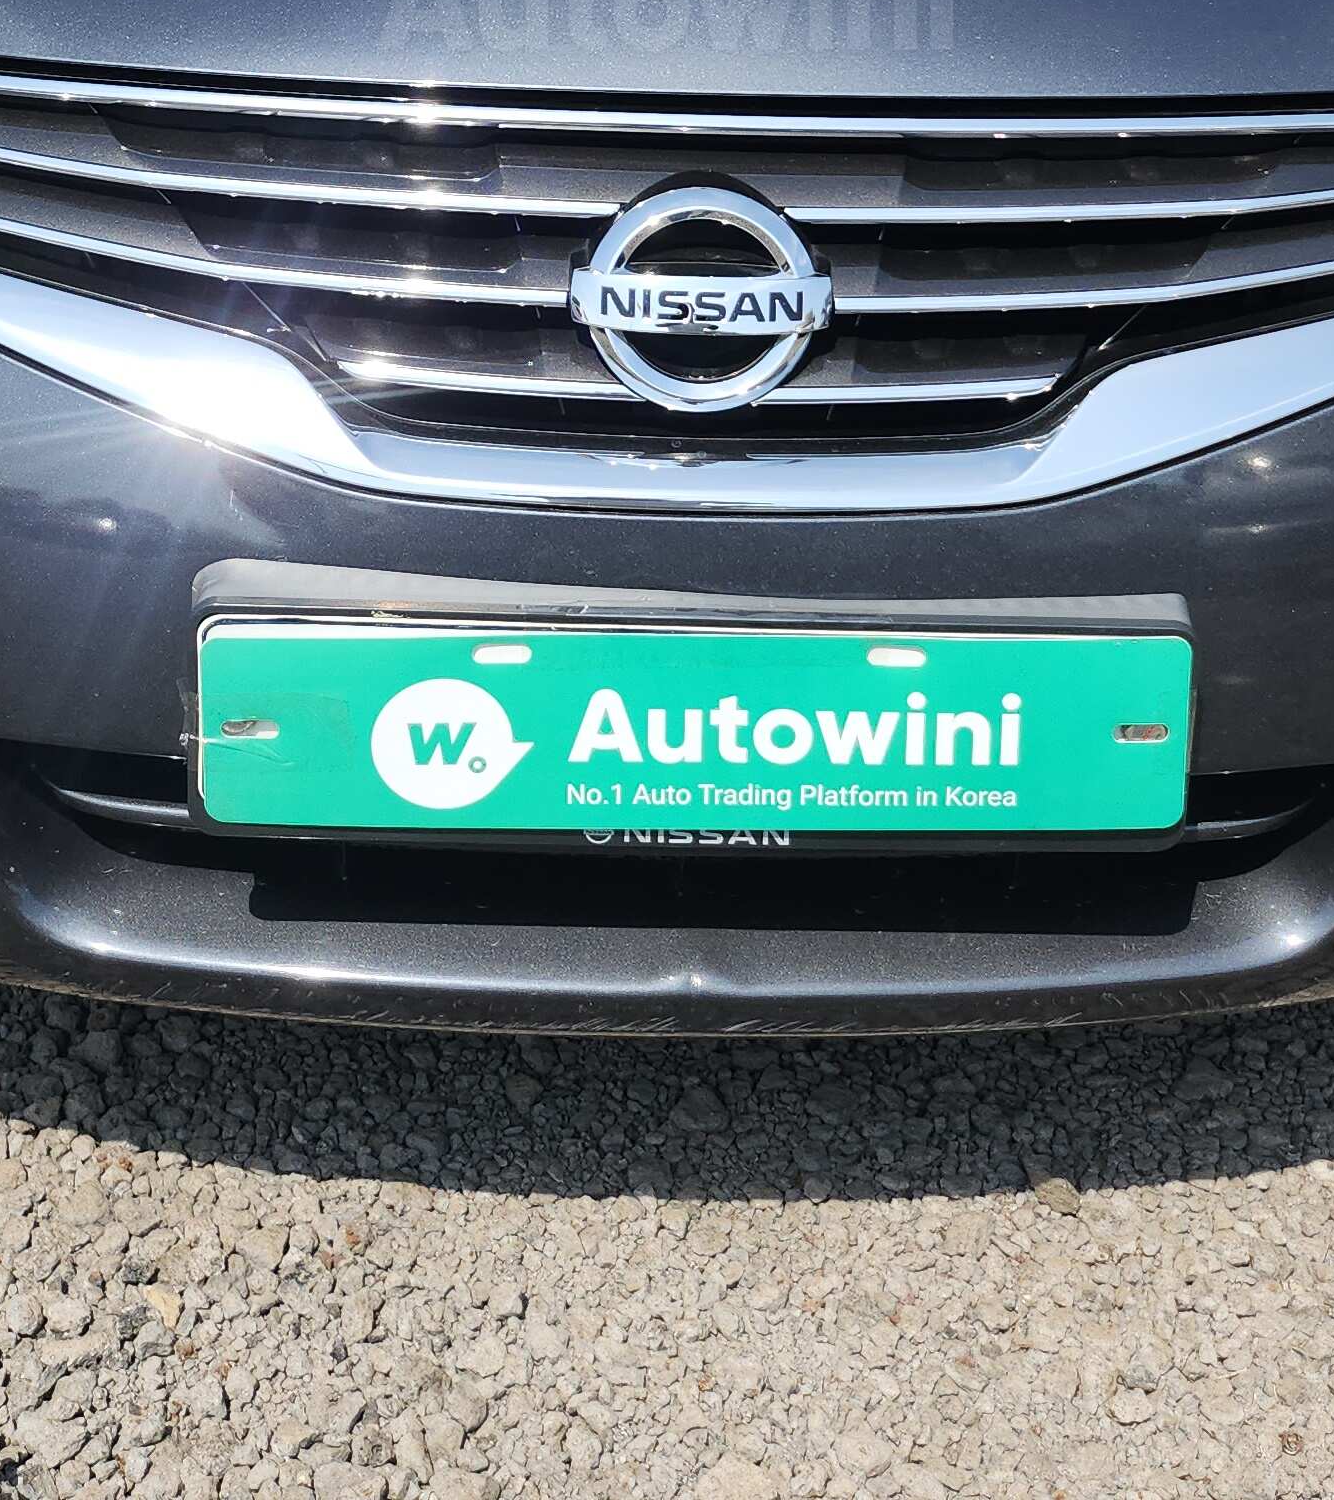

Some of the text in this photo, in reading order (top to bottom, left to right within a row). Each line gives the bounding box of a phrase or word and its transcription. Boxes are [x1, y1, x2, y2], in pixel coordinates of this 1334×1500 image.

[601, 286, 804, 322] NISSAN
[567, 688, 1022, 765] Autowini
[566, 783, 1017, 810] No.1 Auto Trading Platform in Korea
[622, 829, 791, 846] NISSAN
